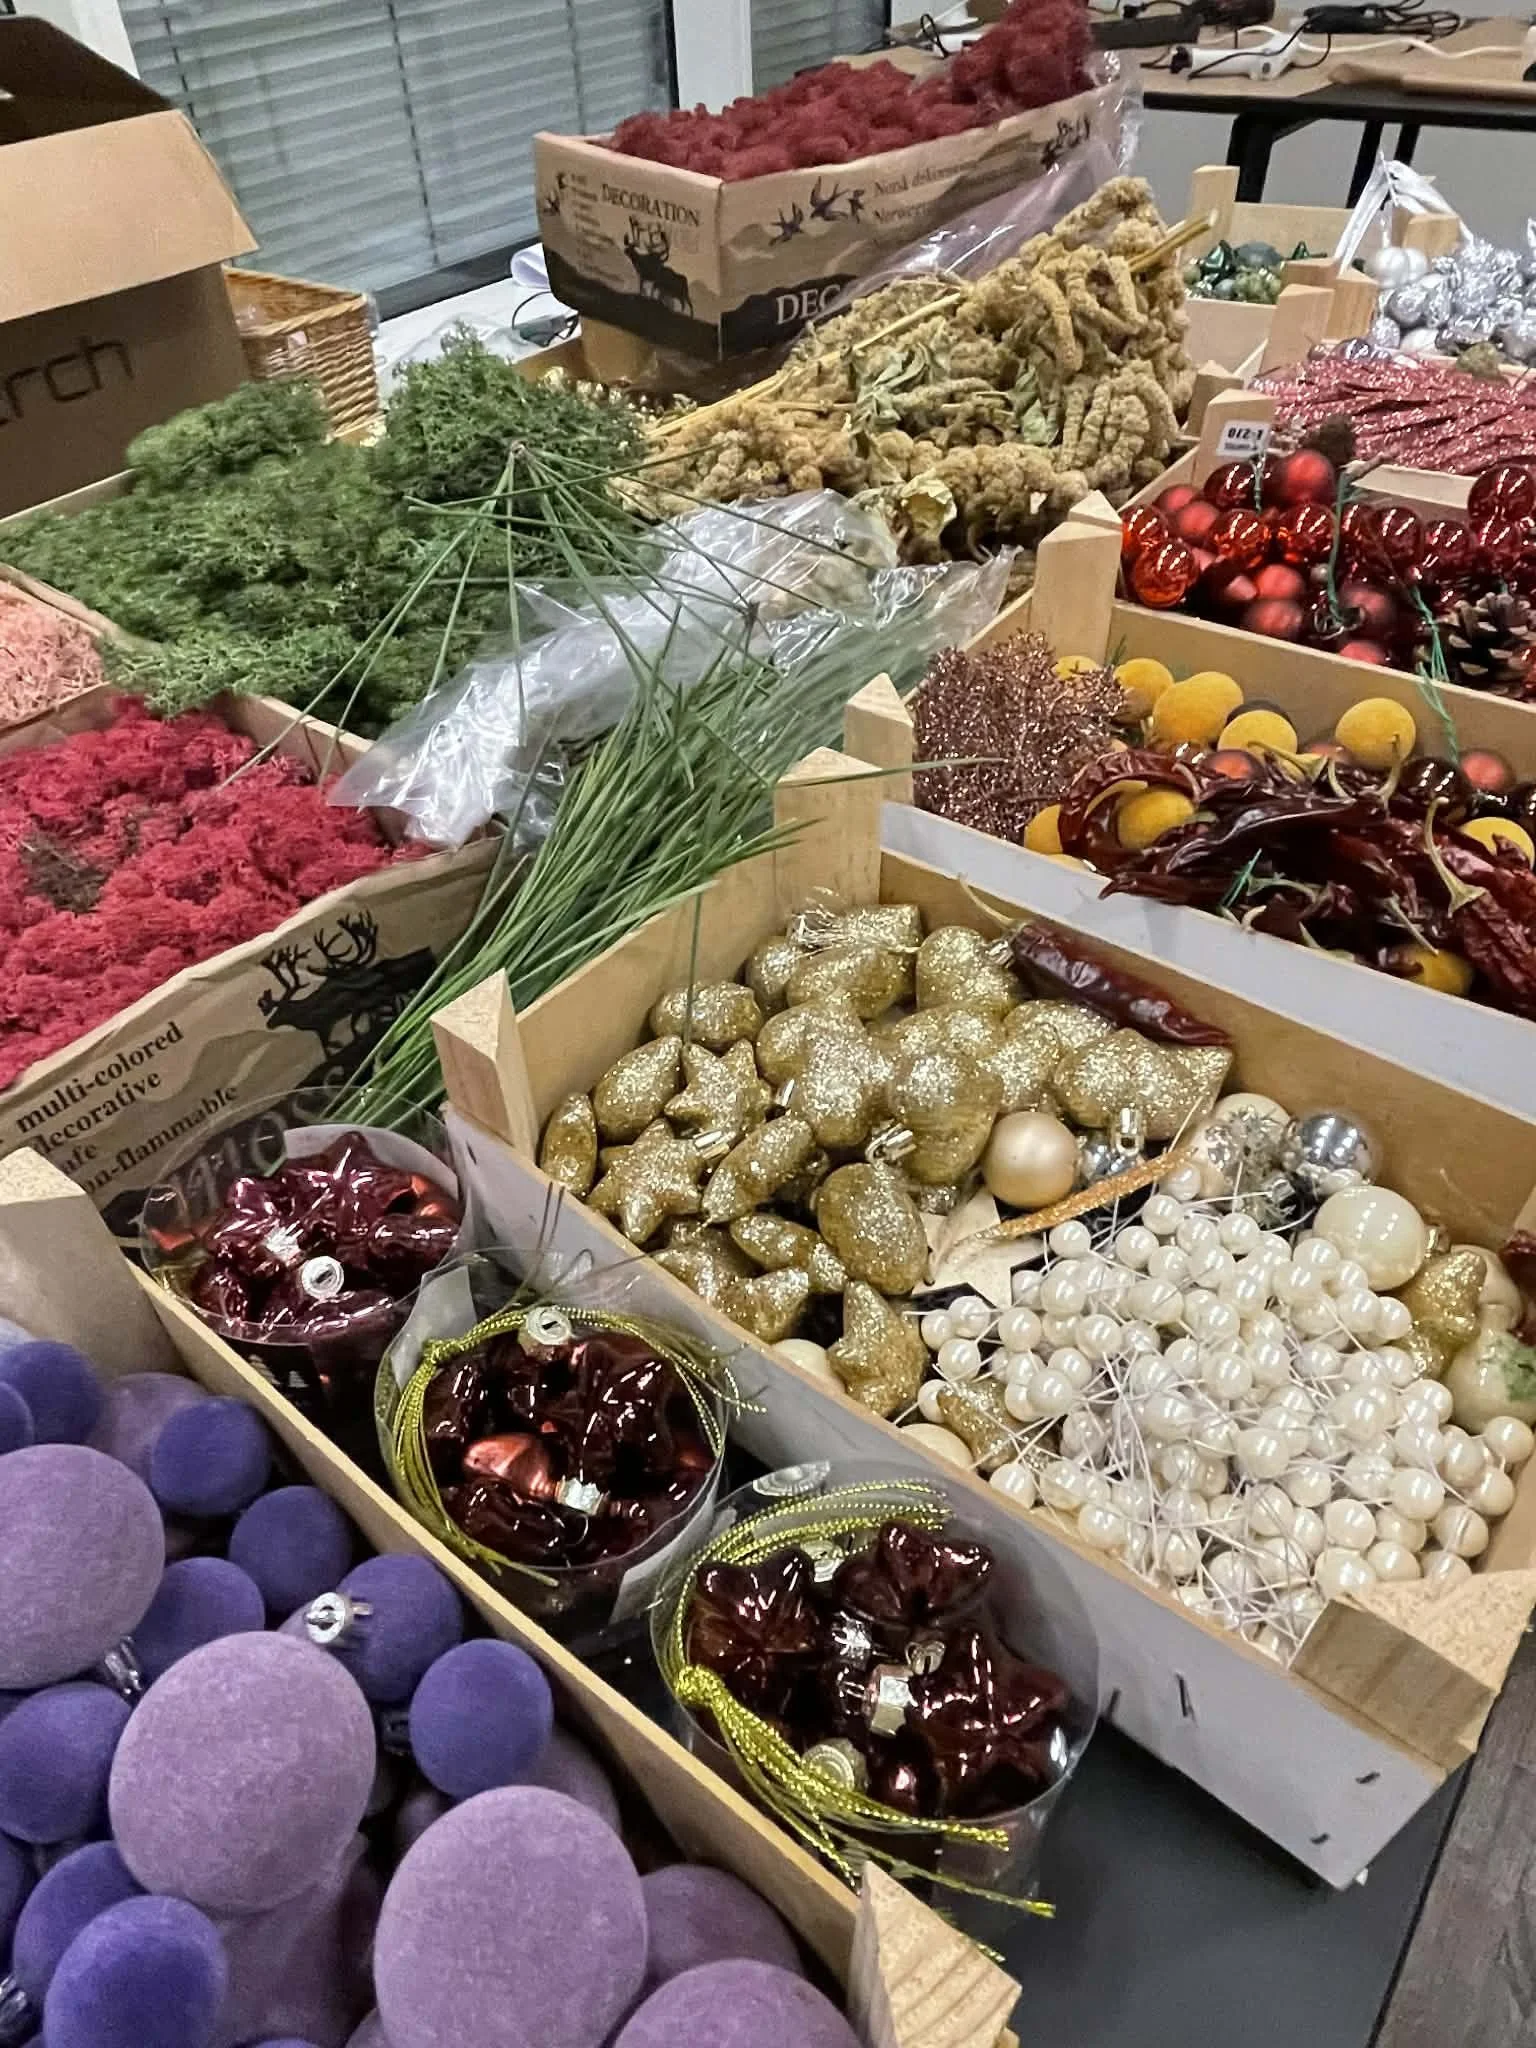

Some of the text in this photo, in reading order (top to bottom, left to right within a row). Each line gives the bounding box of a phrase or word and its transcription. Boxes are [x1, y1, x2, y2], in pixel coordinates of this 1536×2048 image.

[601, 183, 701, 228] DECORATION
[16, 1021, 185, 1135] multi-colored
[60, 1142, 99, 1176] afe
[84, 1083, 240, 1195] on-flammable
